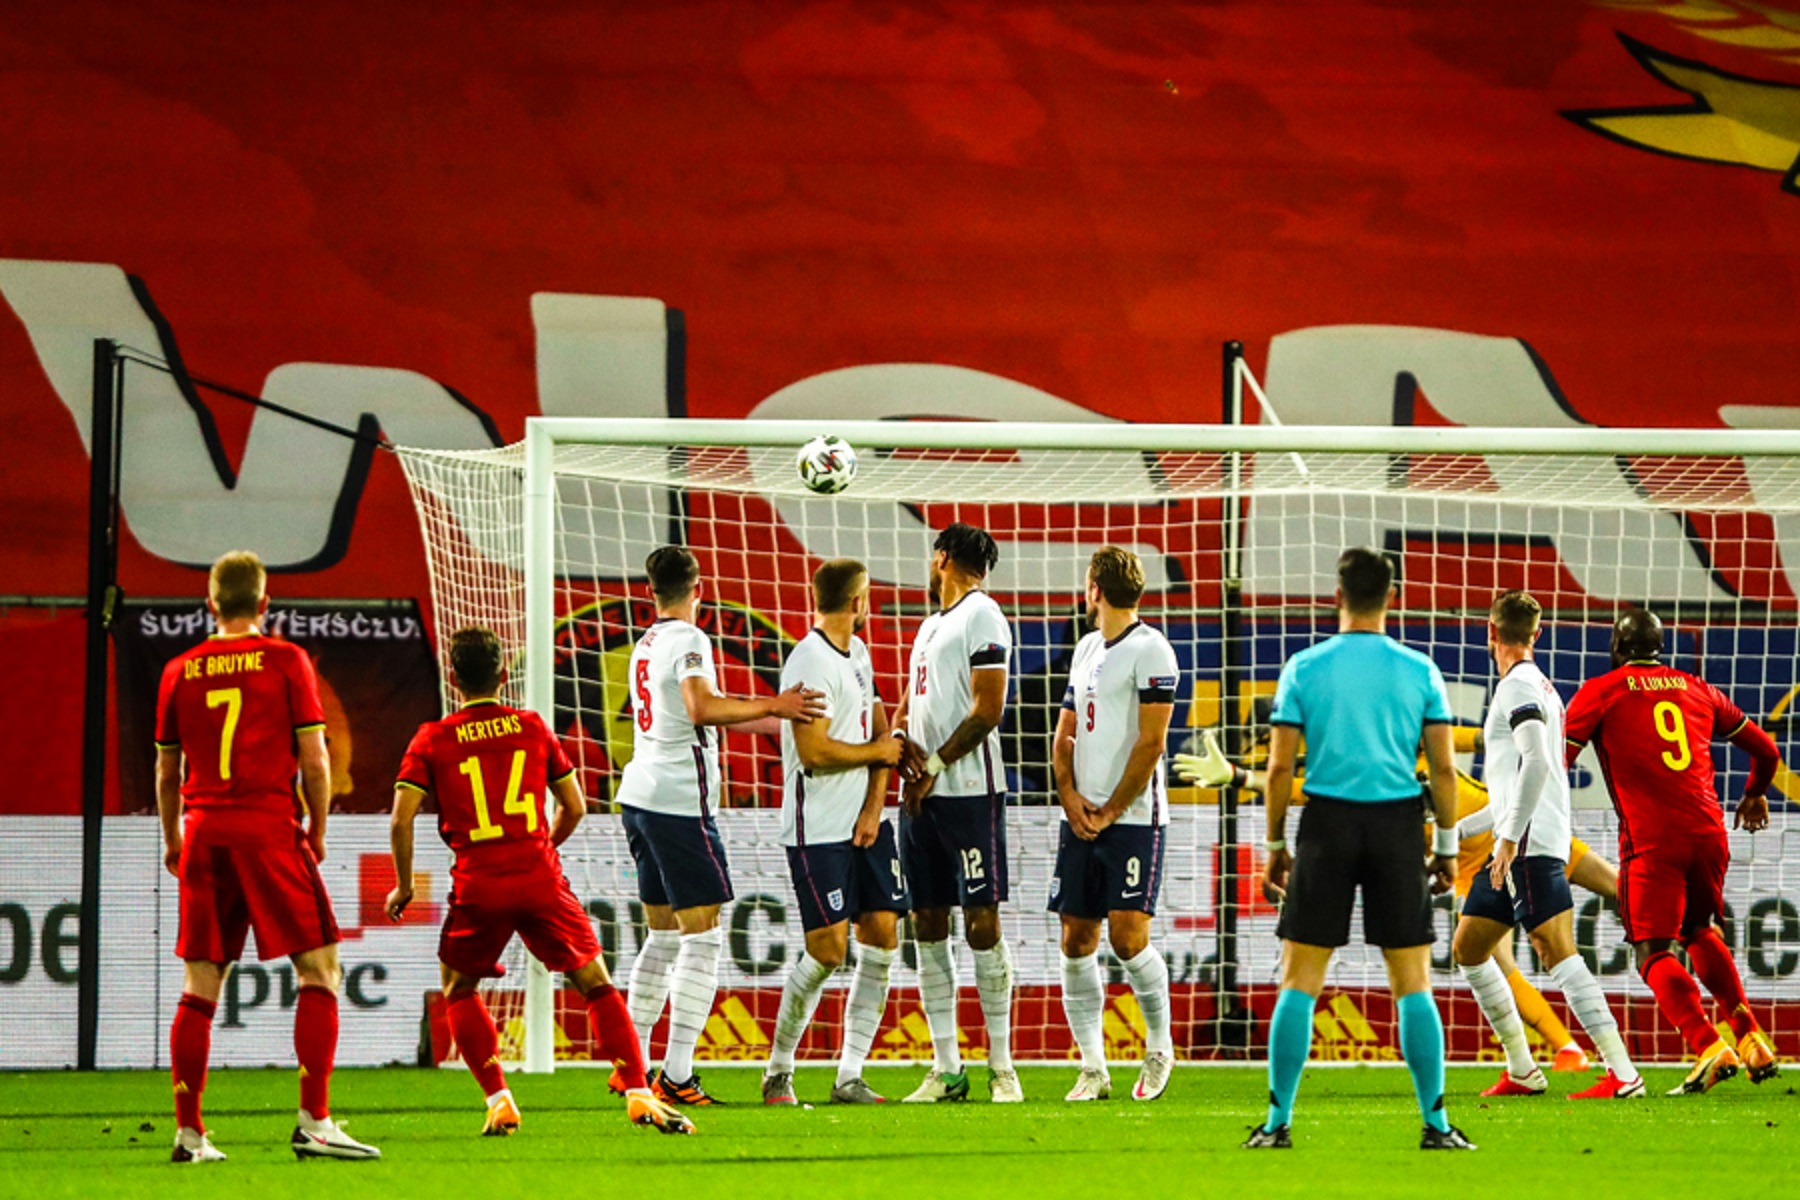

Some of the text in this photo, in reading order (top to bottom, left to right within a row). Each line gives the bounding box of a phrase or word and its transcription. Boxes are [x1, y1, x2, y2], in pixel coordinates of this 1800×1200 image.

[185, 651, 264, 679] DE BRUYNE
[636, 659, 653, 733] 5
[1628, 675, 1688, 691] R. LUKAKU
[456, 714, 522, 743] MERTENS
[1086, 700, 1096, 733] 9
[206, 687, 242, 780] 7
[1653, 701, 1692, 771] 9
[459, 749, 538, 841] 14
[891, 858, 903, 890] 4
[961, 847, 985, 881] 12
[1126, 856, 1141, 886] 9
